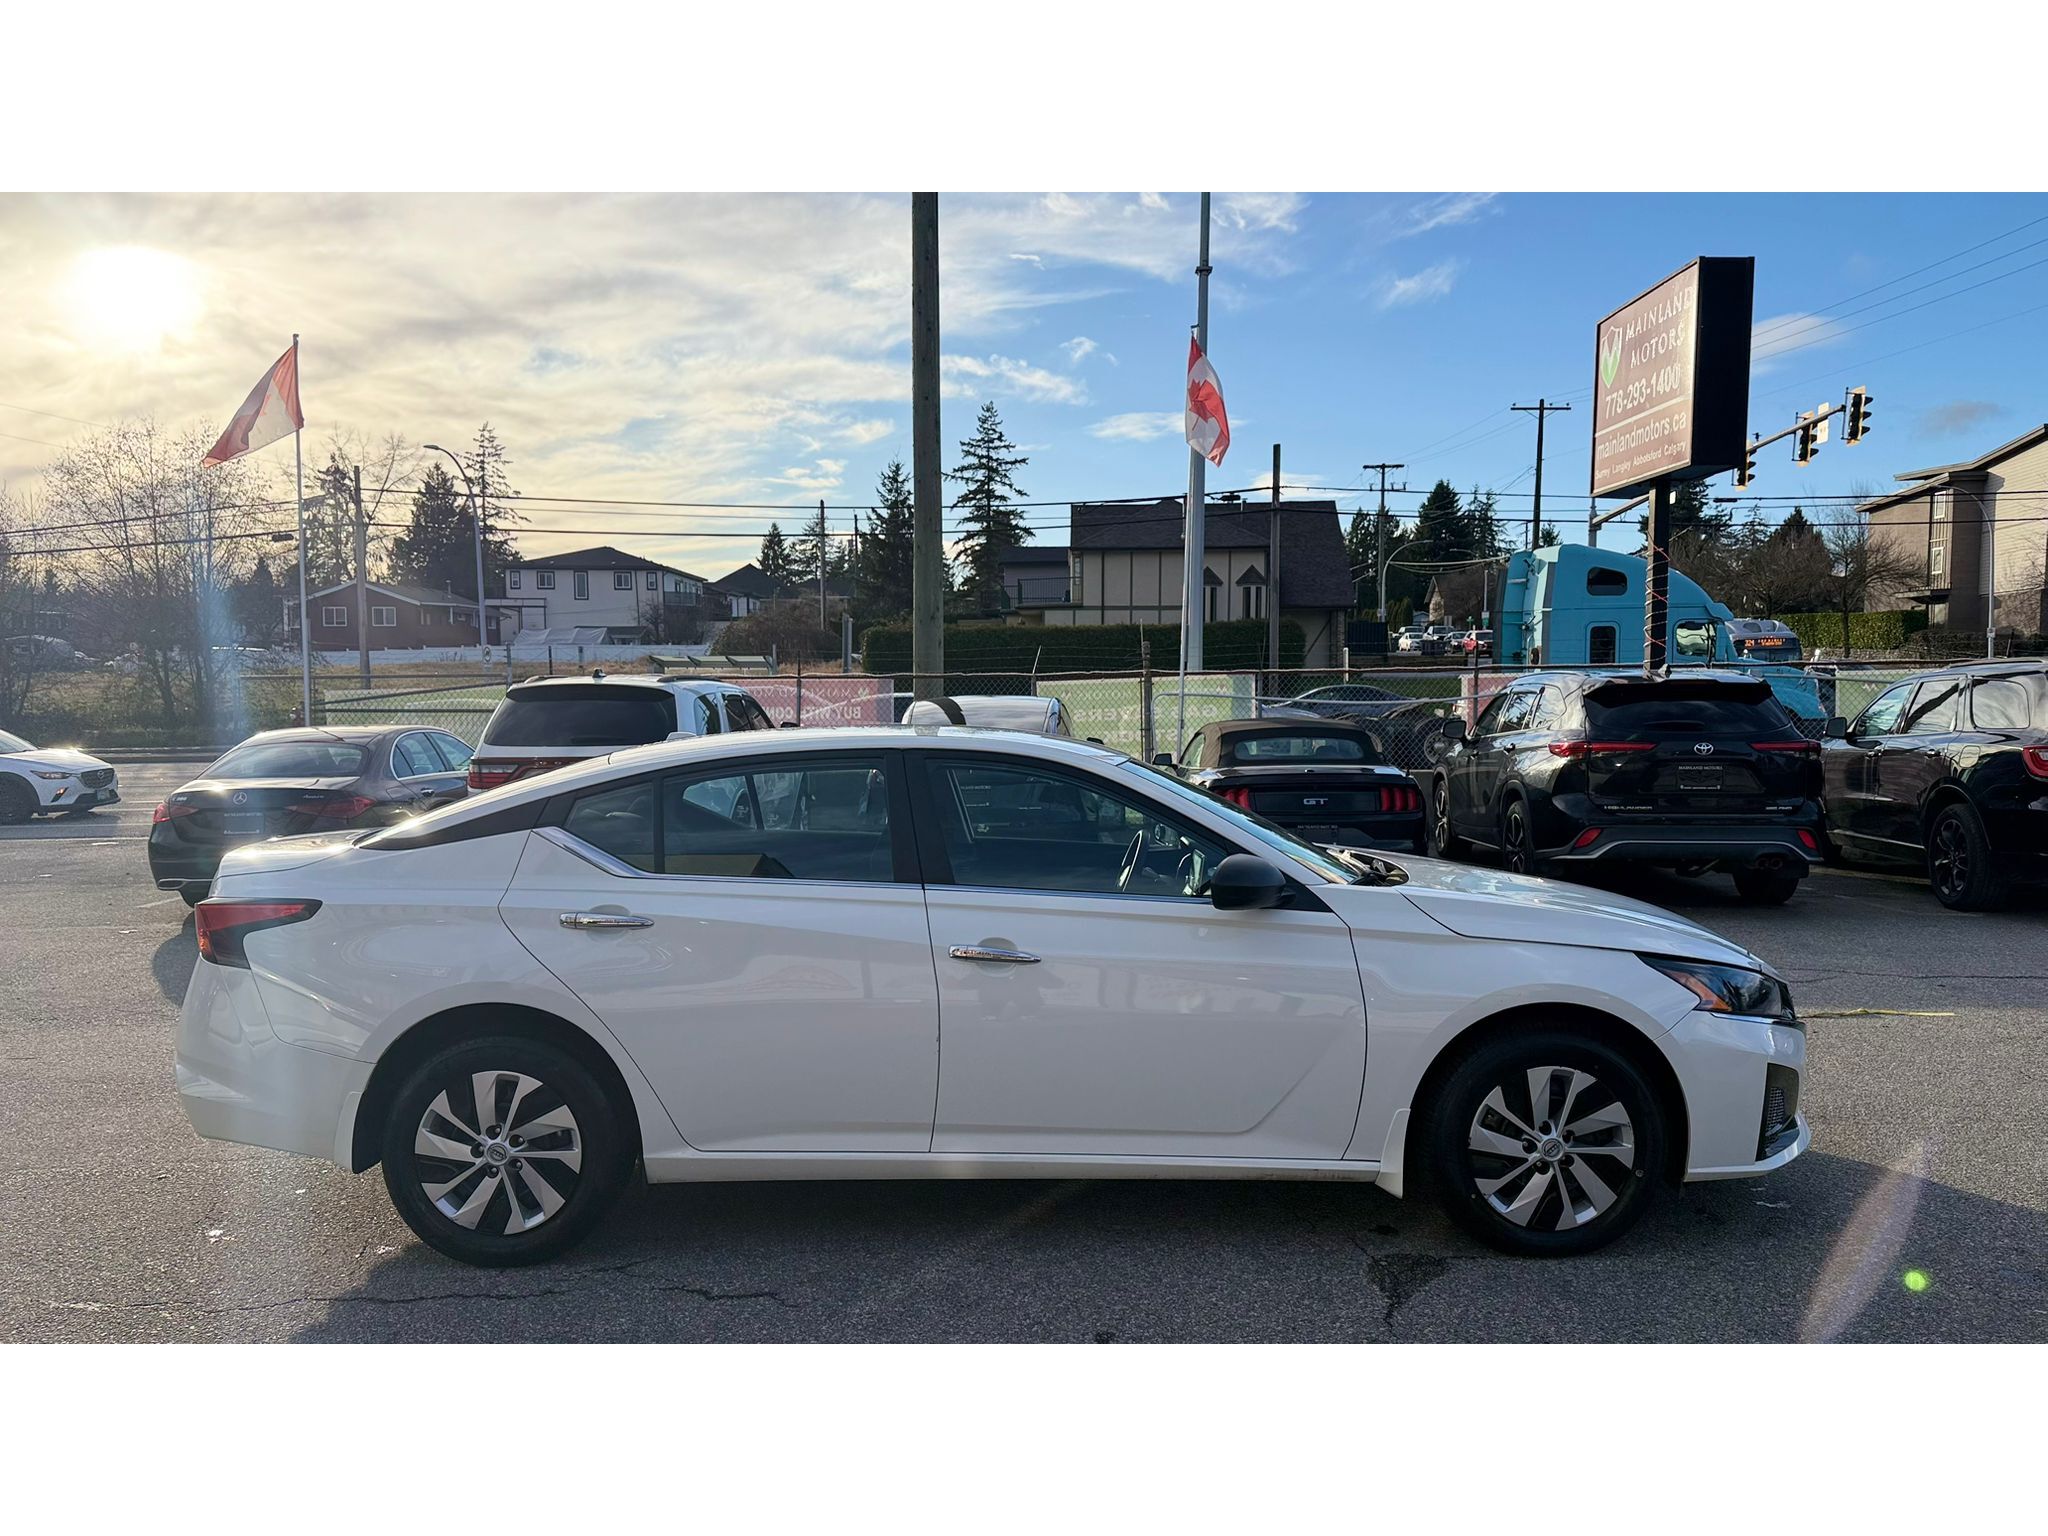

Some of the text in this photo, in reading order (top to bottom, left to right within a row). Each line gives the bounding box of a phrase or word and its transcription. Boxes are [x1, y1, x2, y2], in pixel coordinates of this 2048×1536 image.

[1625, 286, 1693, 341] MAINLAND
[1630, 320, 1684, 369] MOTORS
[1605, 362, 1682, 419] 778-293-1400
[1597, 411, 1687, 460] mainlandmotors.ca
[1663, 440, 1687, 455] Calgary
